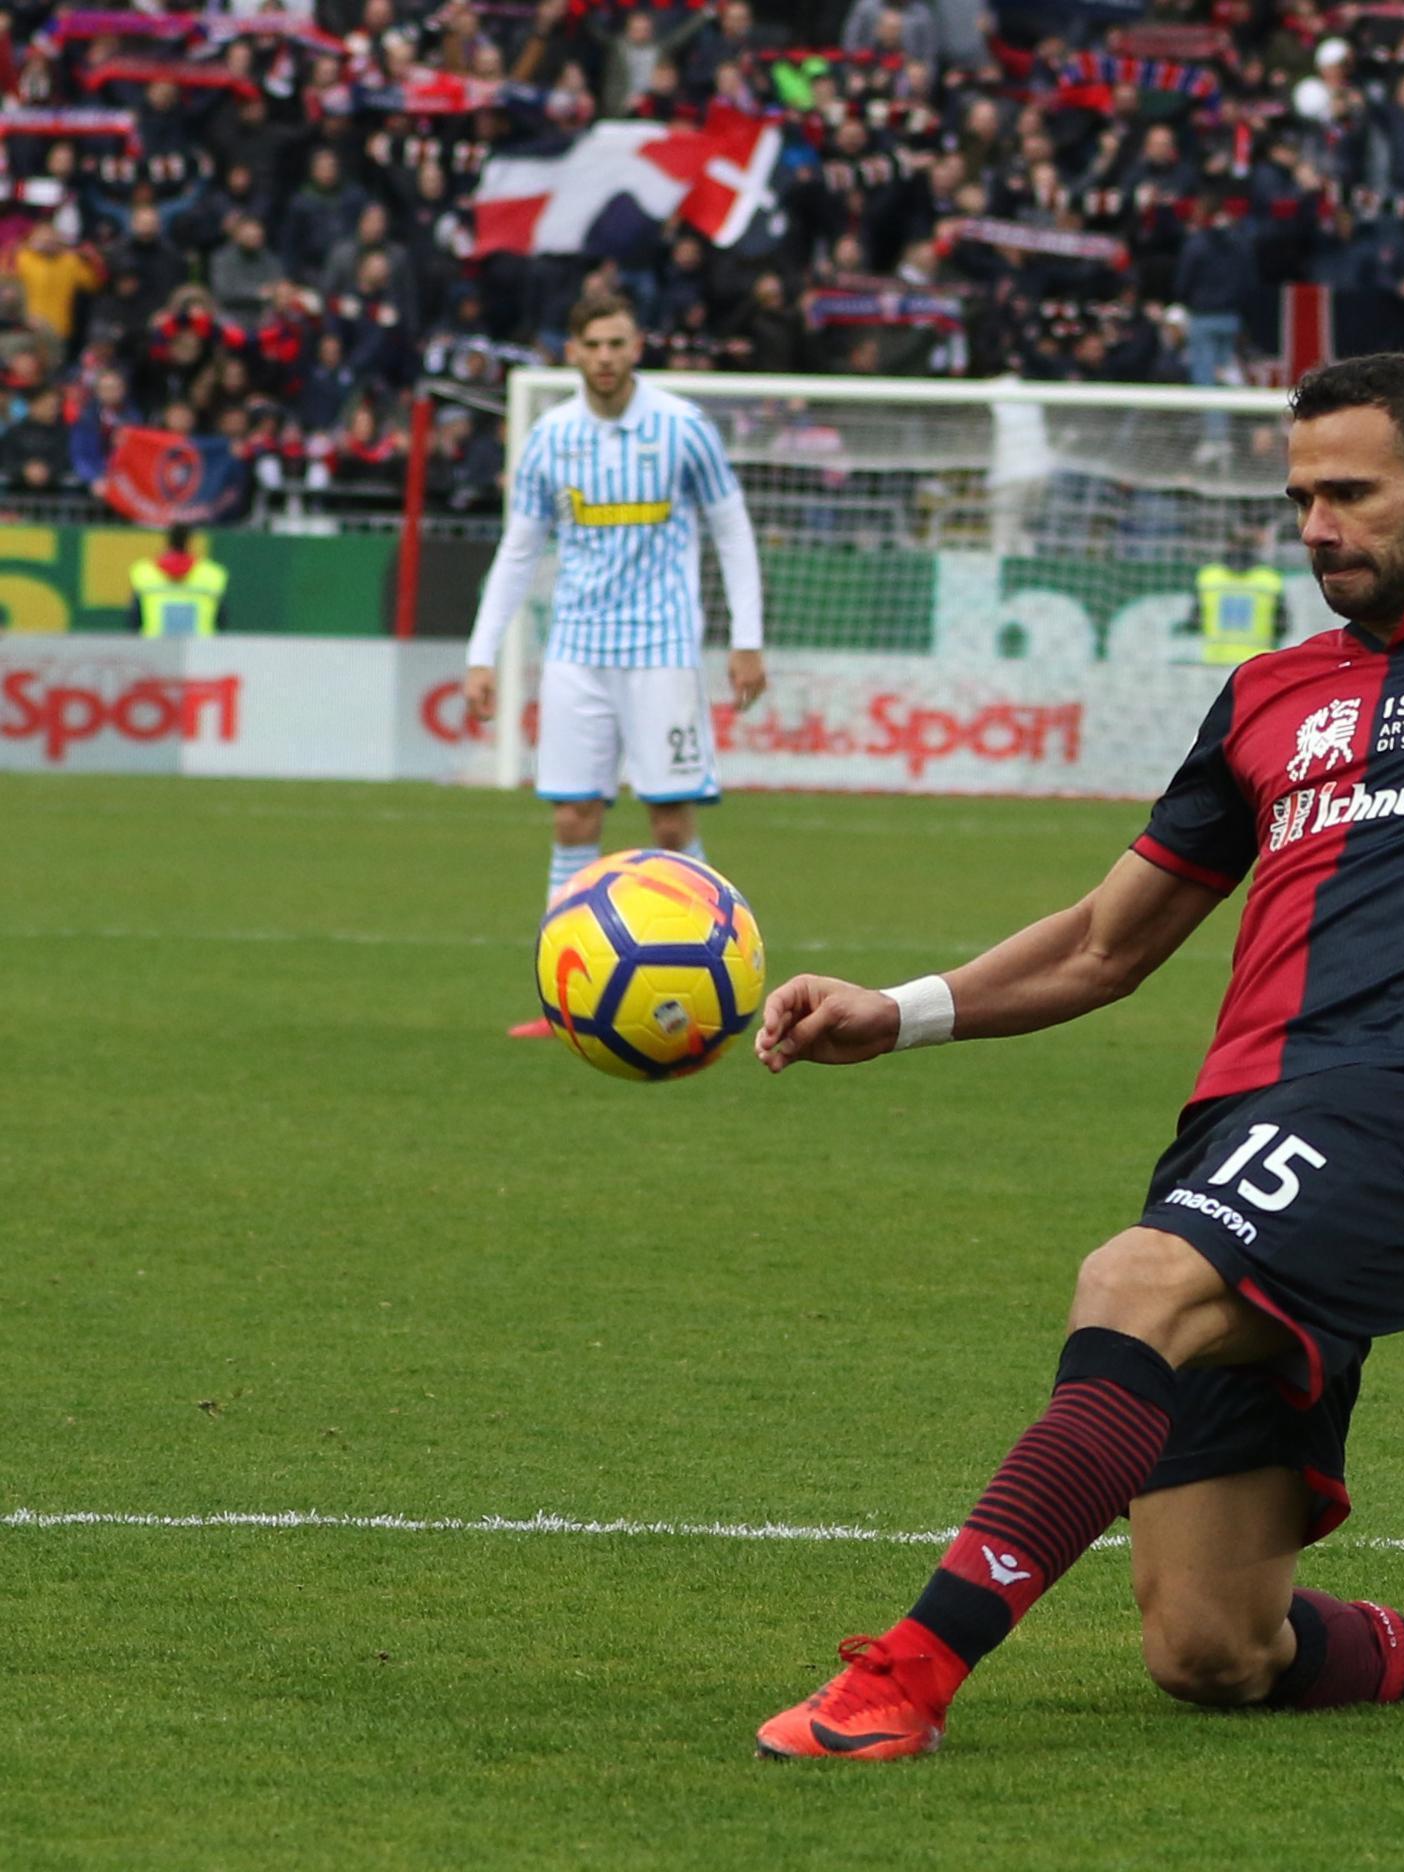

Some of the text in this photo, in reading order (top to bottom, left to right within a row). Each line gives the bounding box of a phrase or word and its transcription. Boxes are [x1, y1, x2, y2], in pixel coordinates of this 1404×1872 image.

[1377, 736, 1395, 753] DI
[1207, 1122, 1328, 1213] 15
[1164, 1187, 1258, 1245] macron
